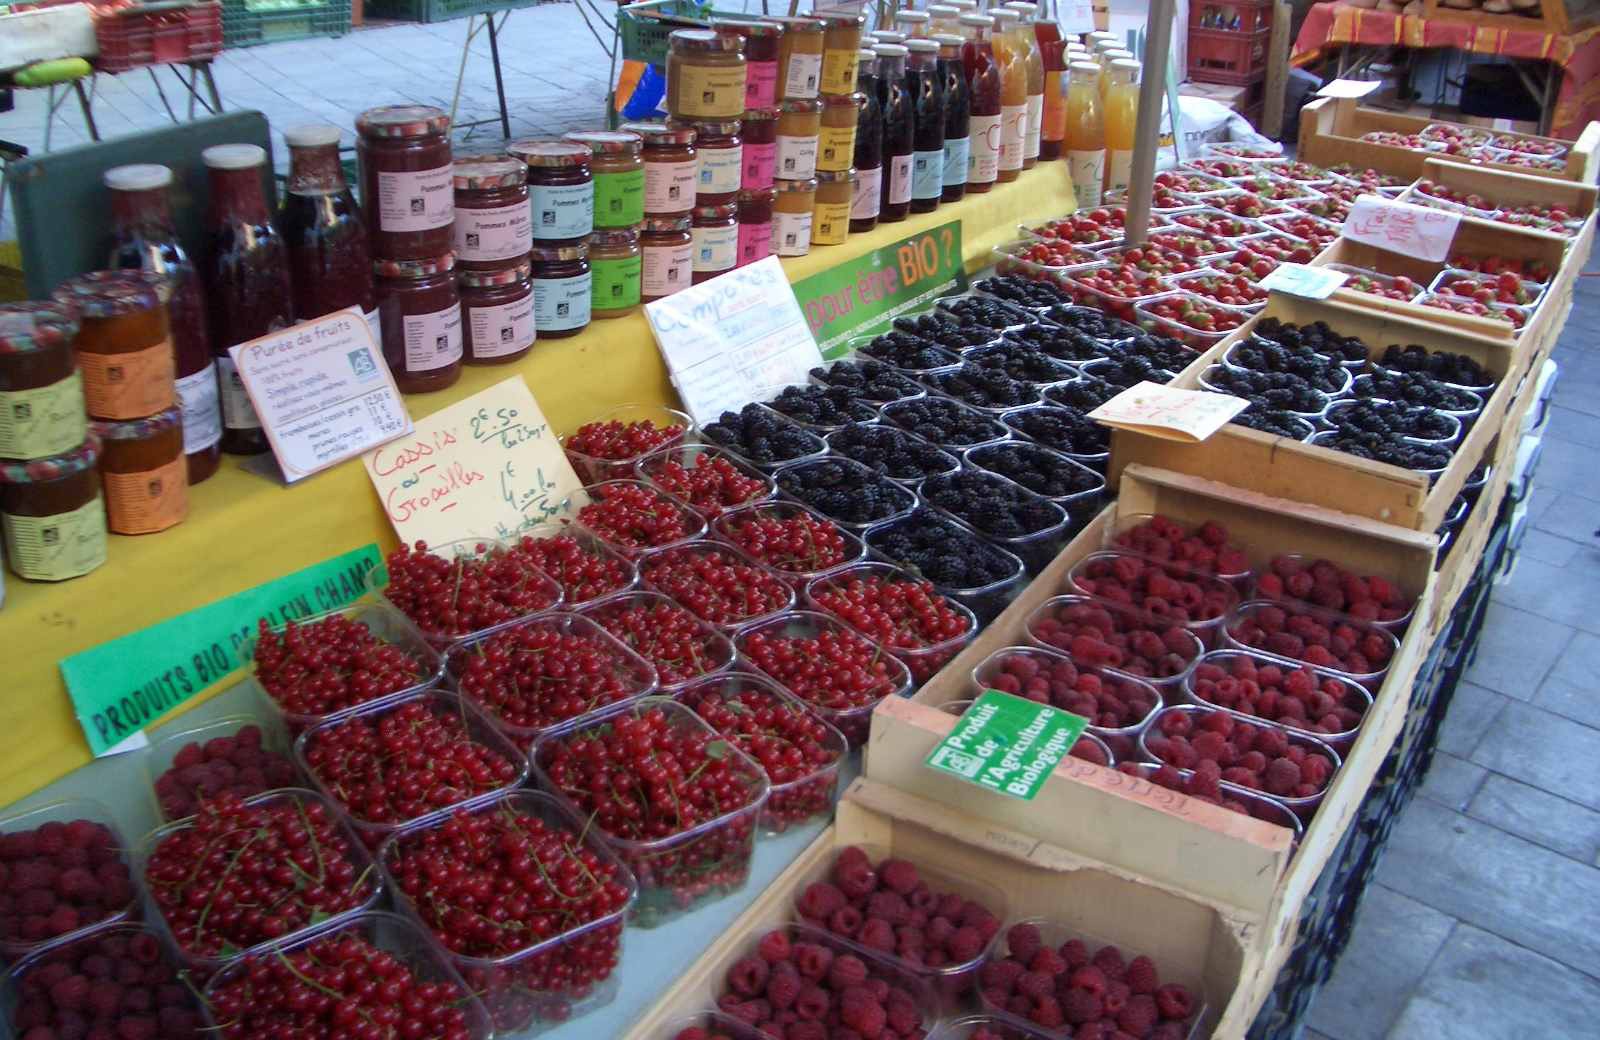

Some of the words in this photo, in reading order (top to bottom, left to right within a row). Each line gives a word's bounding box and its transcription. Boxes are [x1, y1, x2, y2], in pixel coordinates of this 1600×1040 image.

[805, 284, 853, 336] pour
[897, 235, 939, 287] BIO
[941, 229, 953, 268] ?
[251, 341, 292, 361] Purée
[296, 332, 312, 347] de
[314, 320, 351, 340] fruits
[372, 430, 458, 477] Cassis
[386, 461, 485, 522] Groseilles
[90, 664, 193, 746] PRODUITS
[192, 643, 230, 684] BIO
[946, 703, 999, 750] Produit
[975, 739, 1000, 758] de
[980, 708, 1056, 787] l'Agriculture
[1006, 727, 1072, 796] Biologique
